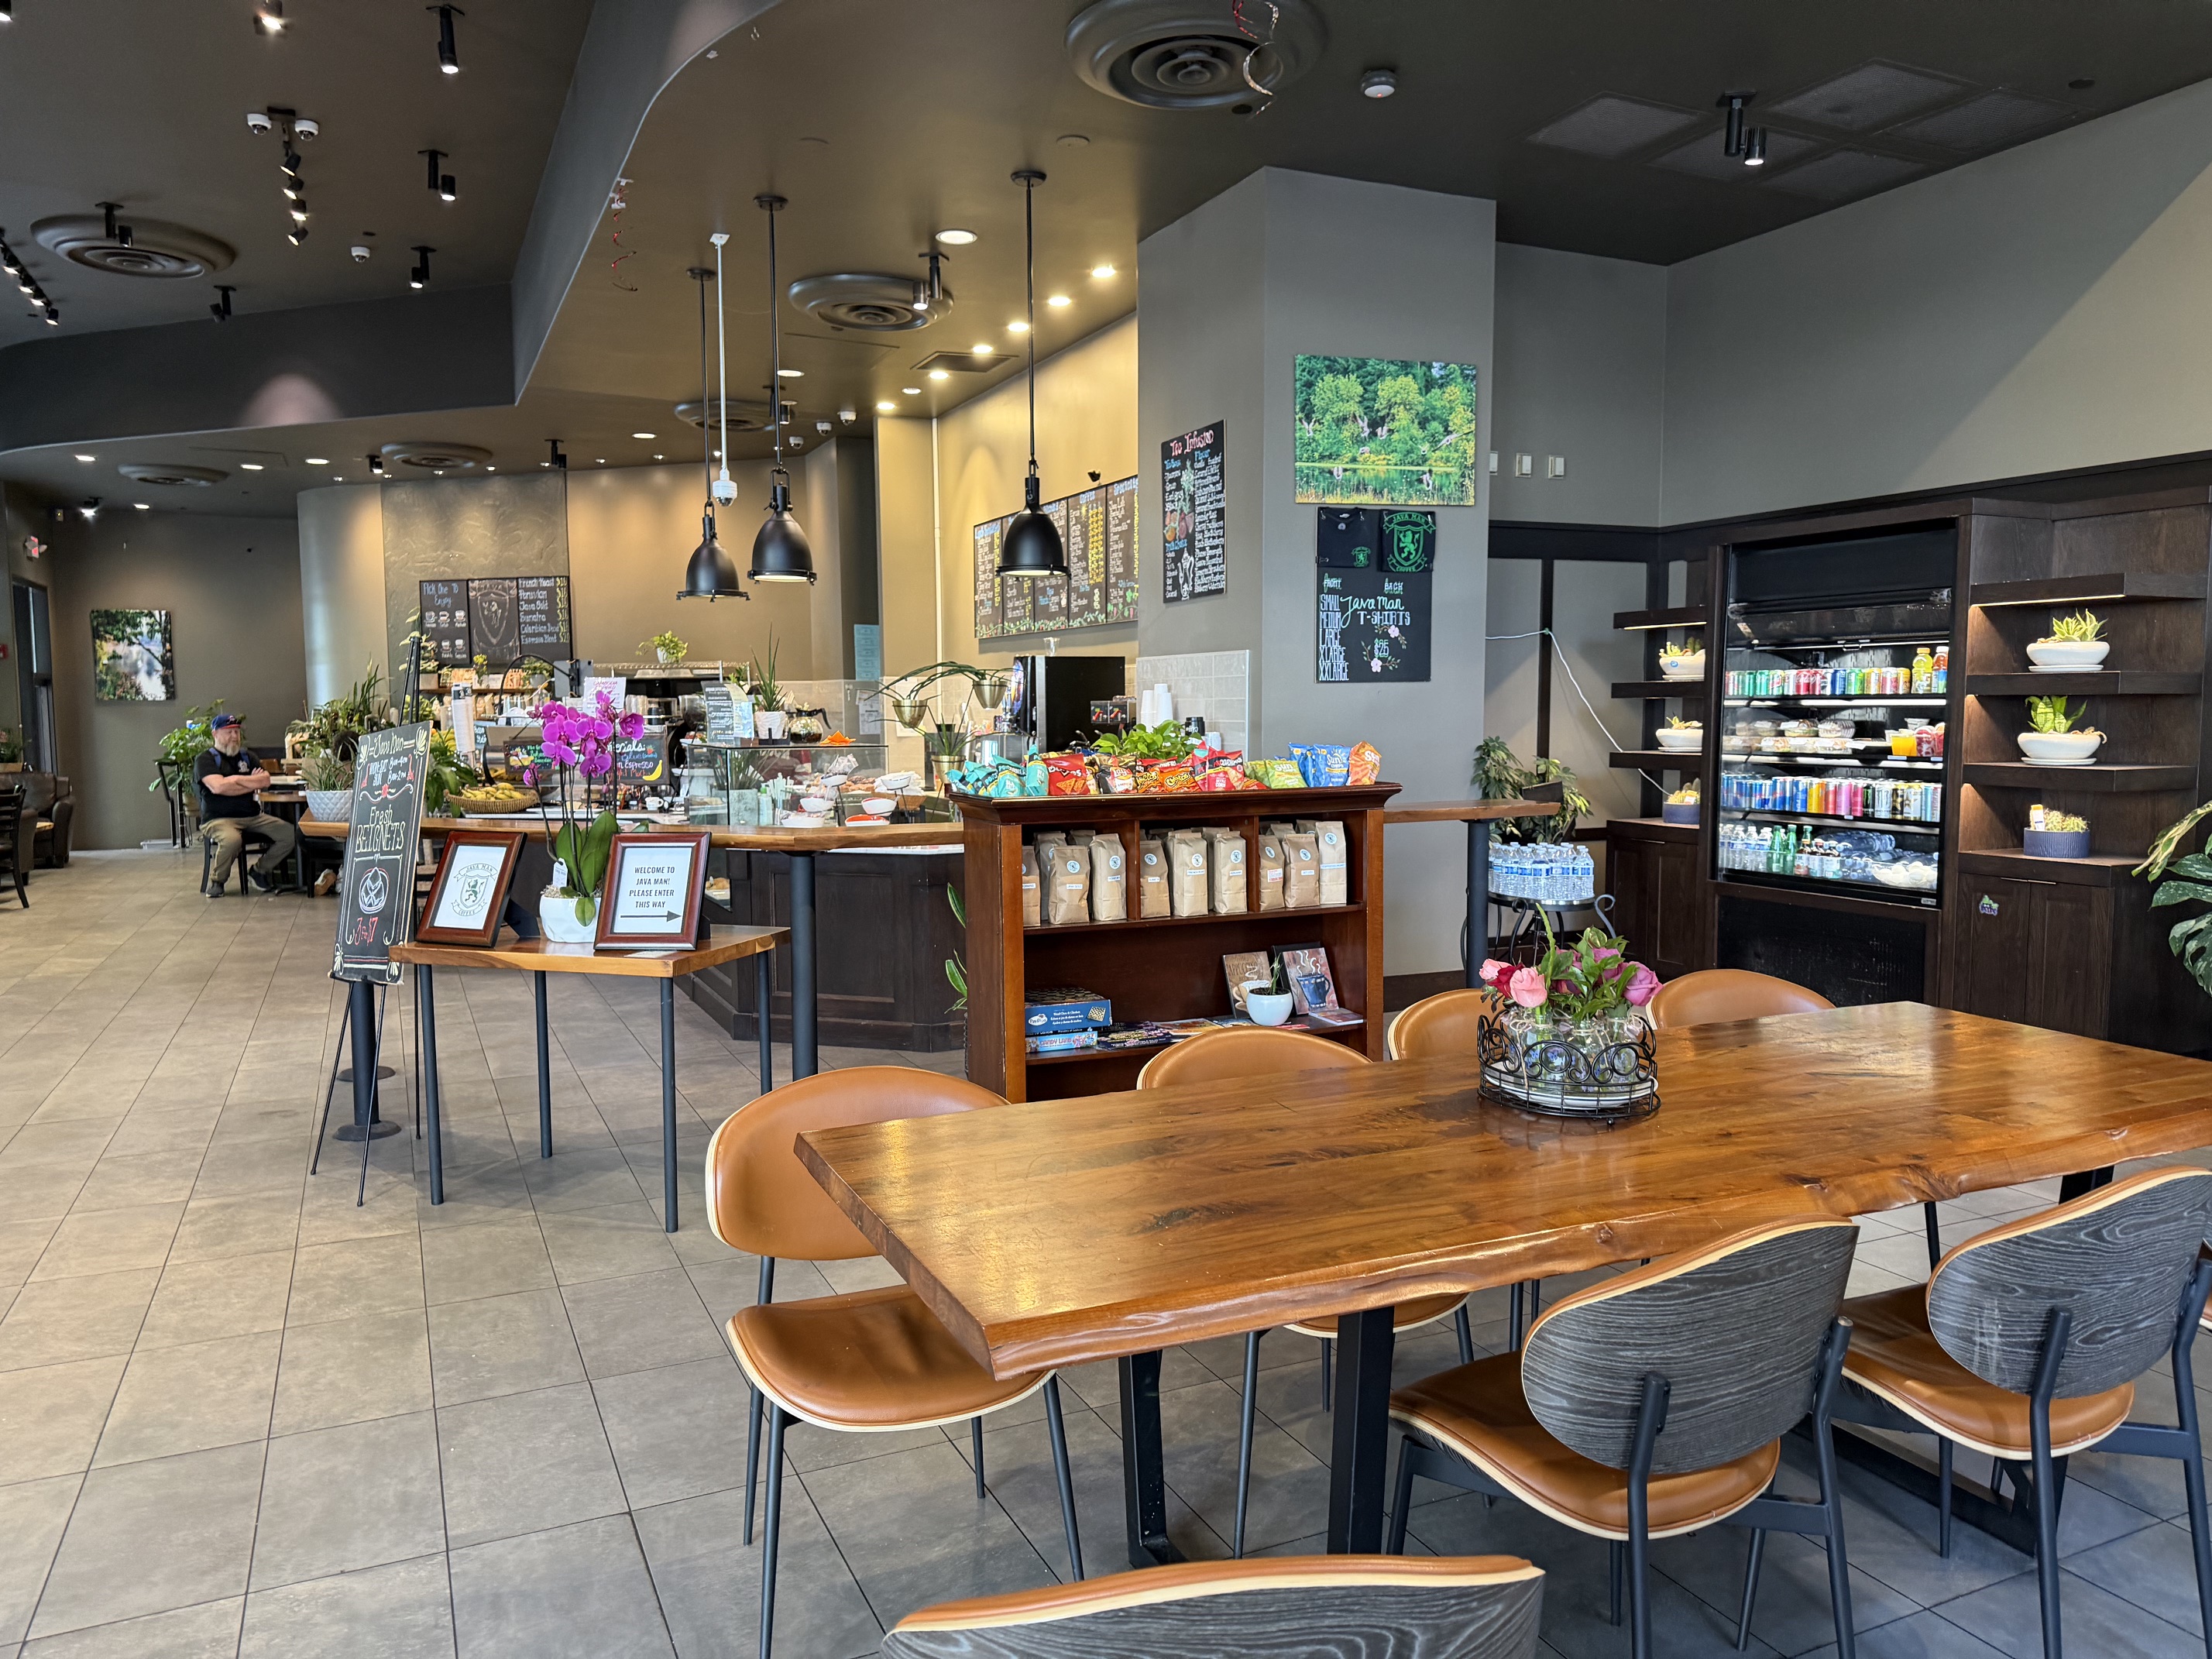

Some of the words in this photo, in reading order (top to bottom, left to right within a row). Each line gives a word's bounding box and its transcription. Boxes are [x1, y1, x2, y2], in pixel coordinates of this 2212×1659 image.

[1393, 514, 1409, 522] JAVA
[1410, 514, 1425, 524] MAN
[1320, 594, 1341, 611] SMALL
[1320, 611, 1341, 628] MEDIUM
[1340, 596, 1376, 628] Java
[1357, 610, 1411, 626] T-SHIRTS
[1320, 628, 1341, 647] LARGE
[1319, 646, 1346, 663] XLARGE
[1373, 641, 1389, 658] $25
[1319, 662, 1349, 681] XXLARGE
[1327, 754, 1342, 766] Sun
[369, 804, 393, 826] Fresh
[355, 821, 406, 853] BEIGNETS
